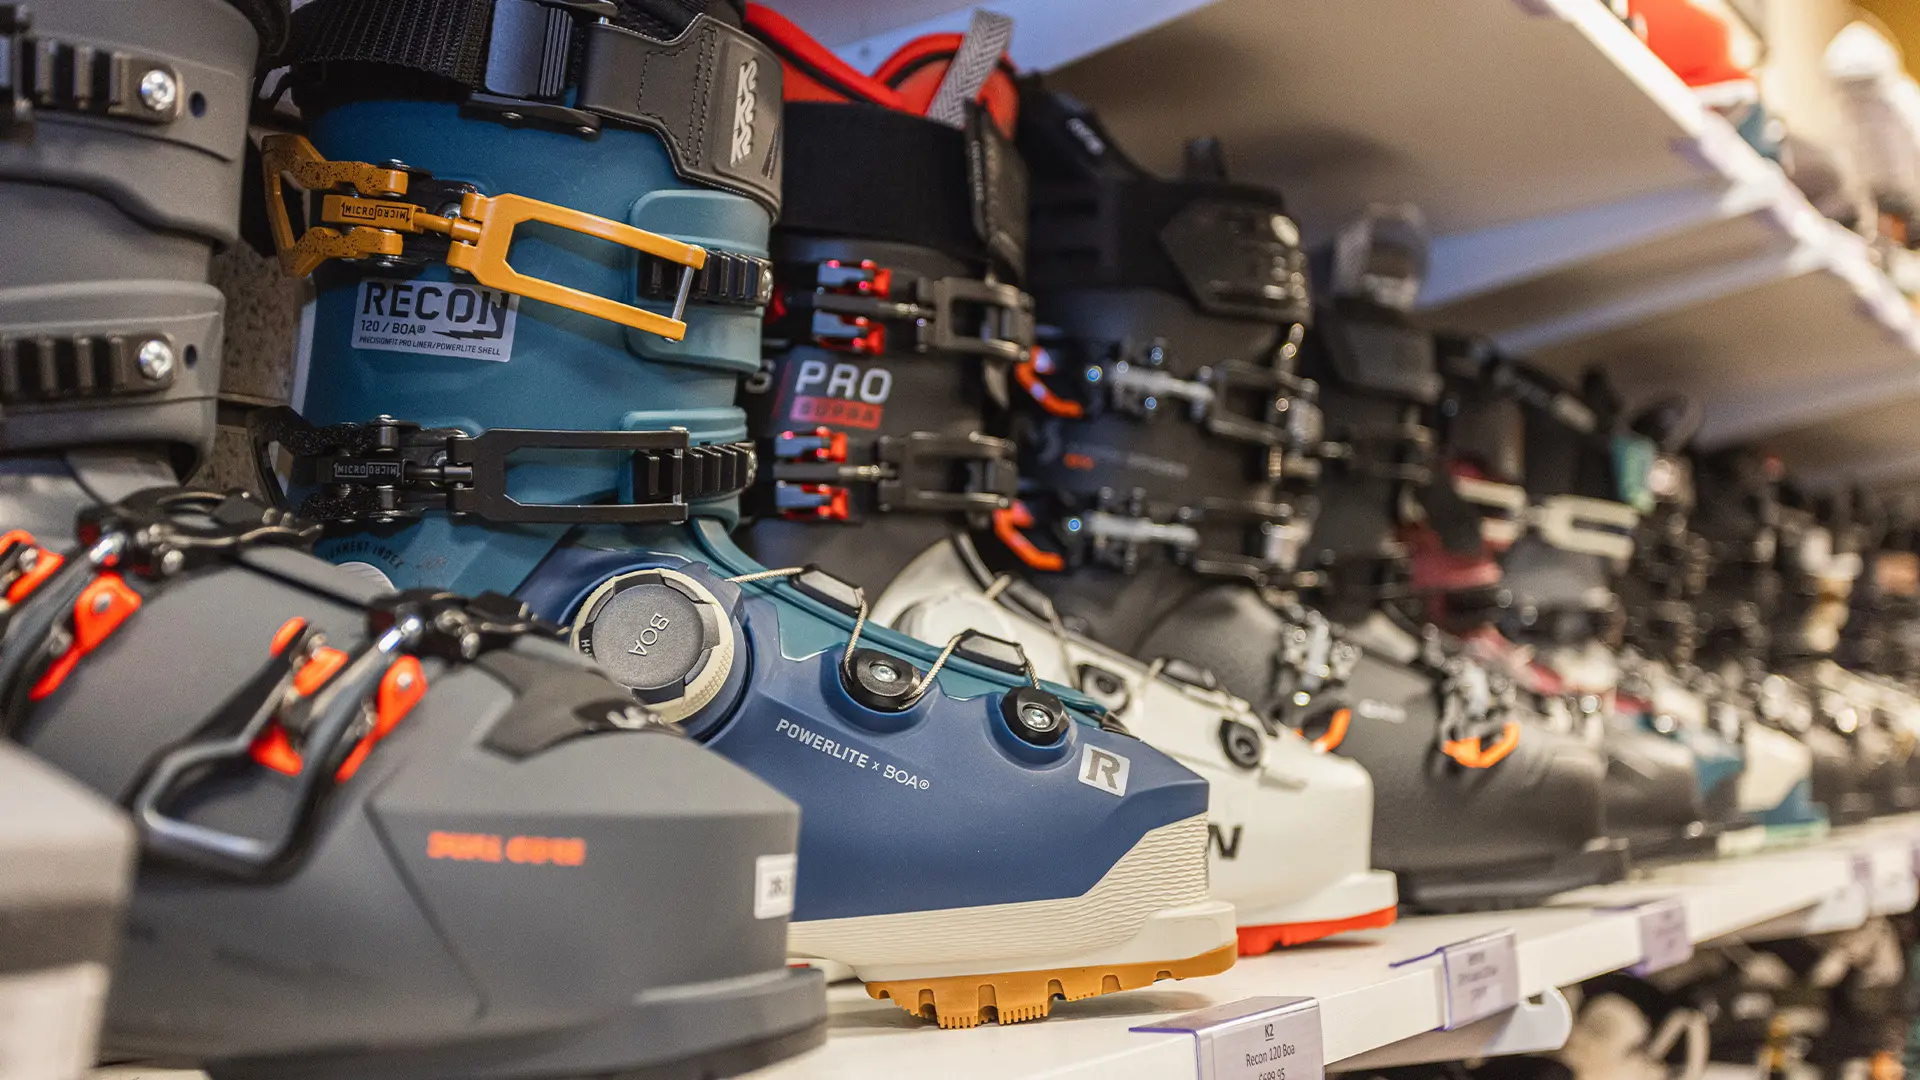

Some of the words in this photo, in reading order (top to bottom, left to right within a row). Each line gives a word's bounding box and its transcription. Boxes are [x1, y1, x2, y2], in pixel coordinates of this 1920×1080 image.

[345, 205, 375, 217] MICRO
[362, 282, 510, 328] RECON
[361, 320, 380, 332] 120
[358, 336, 399, 347] PRECISIONFIT
[399, 338, 412, 348] PRO
[478, 346, 502, 356] SHELL
[795, 360, 893, 404] PRO
[338, 465, 366, 474] MICRO
[628, 612, 670, 656] BOA
[776, 719, 869, 769] POWERLITE
[1085, 749, 1121, 790] R
[1264, 1023, 1275, 1038] K2
[1246, 1052, 1268, 1068] Recon
[1269, 1045, 1281, 1061] 120
[1283, 1044, 1295, 1057] Boa
